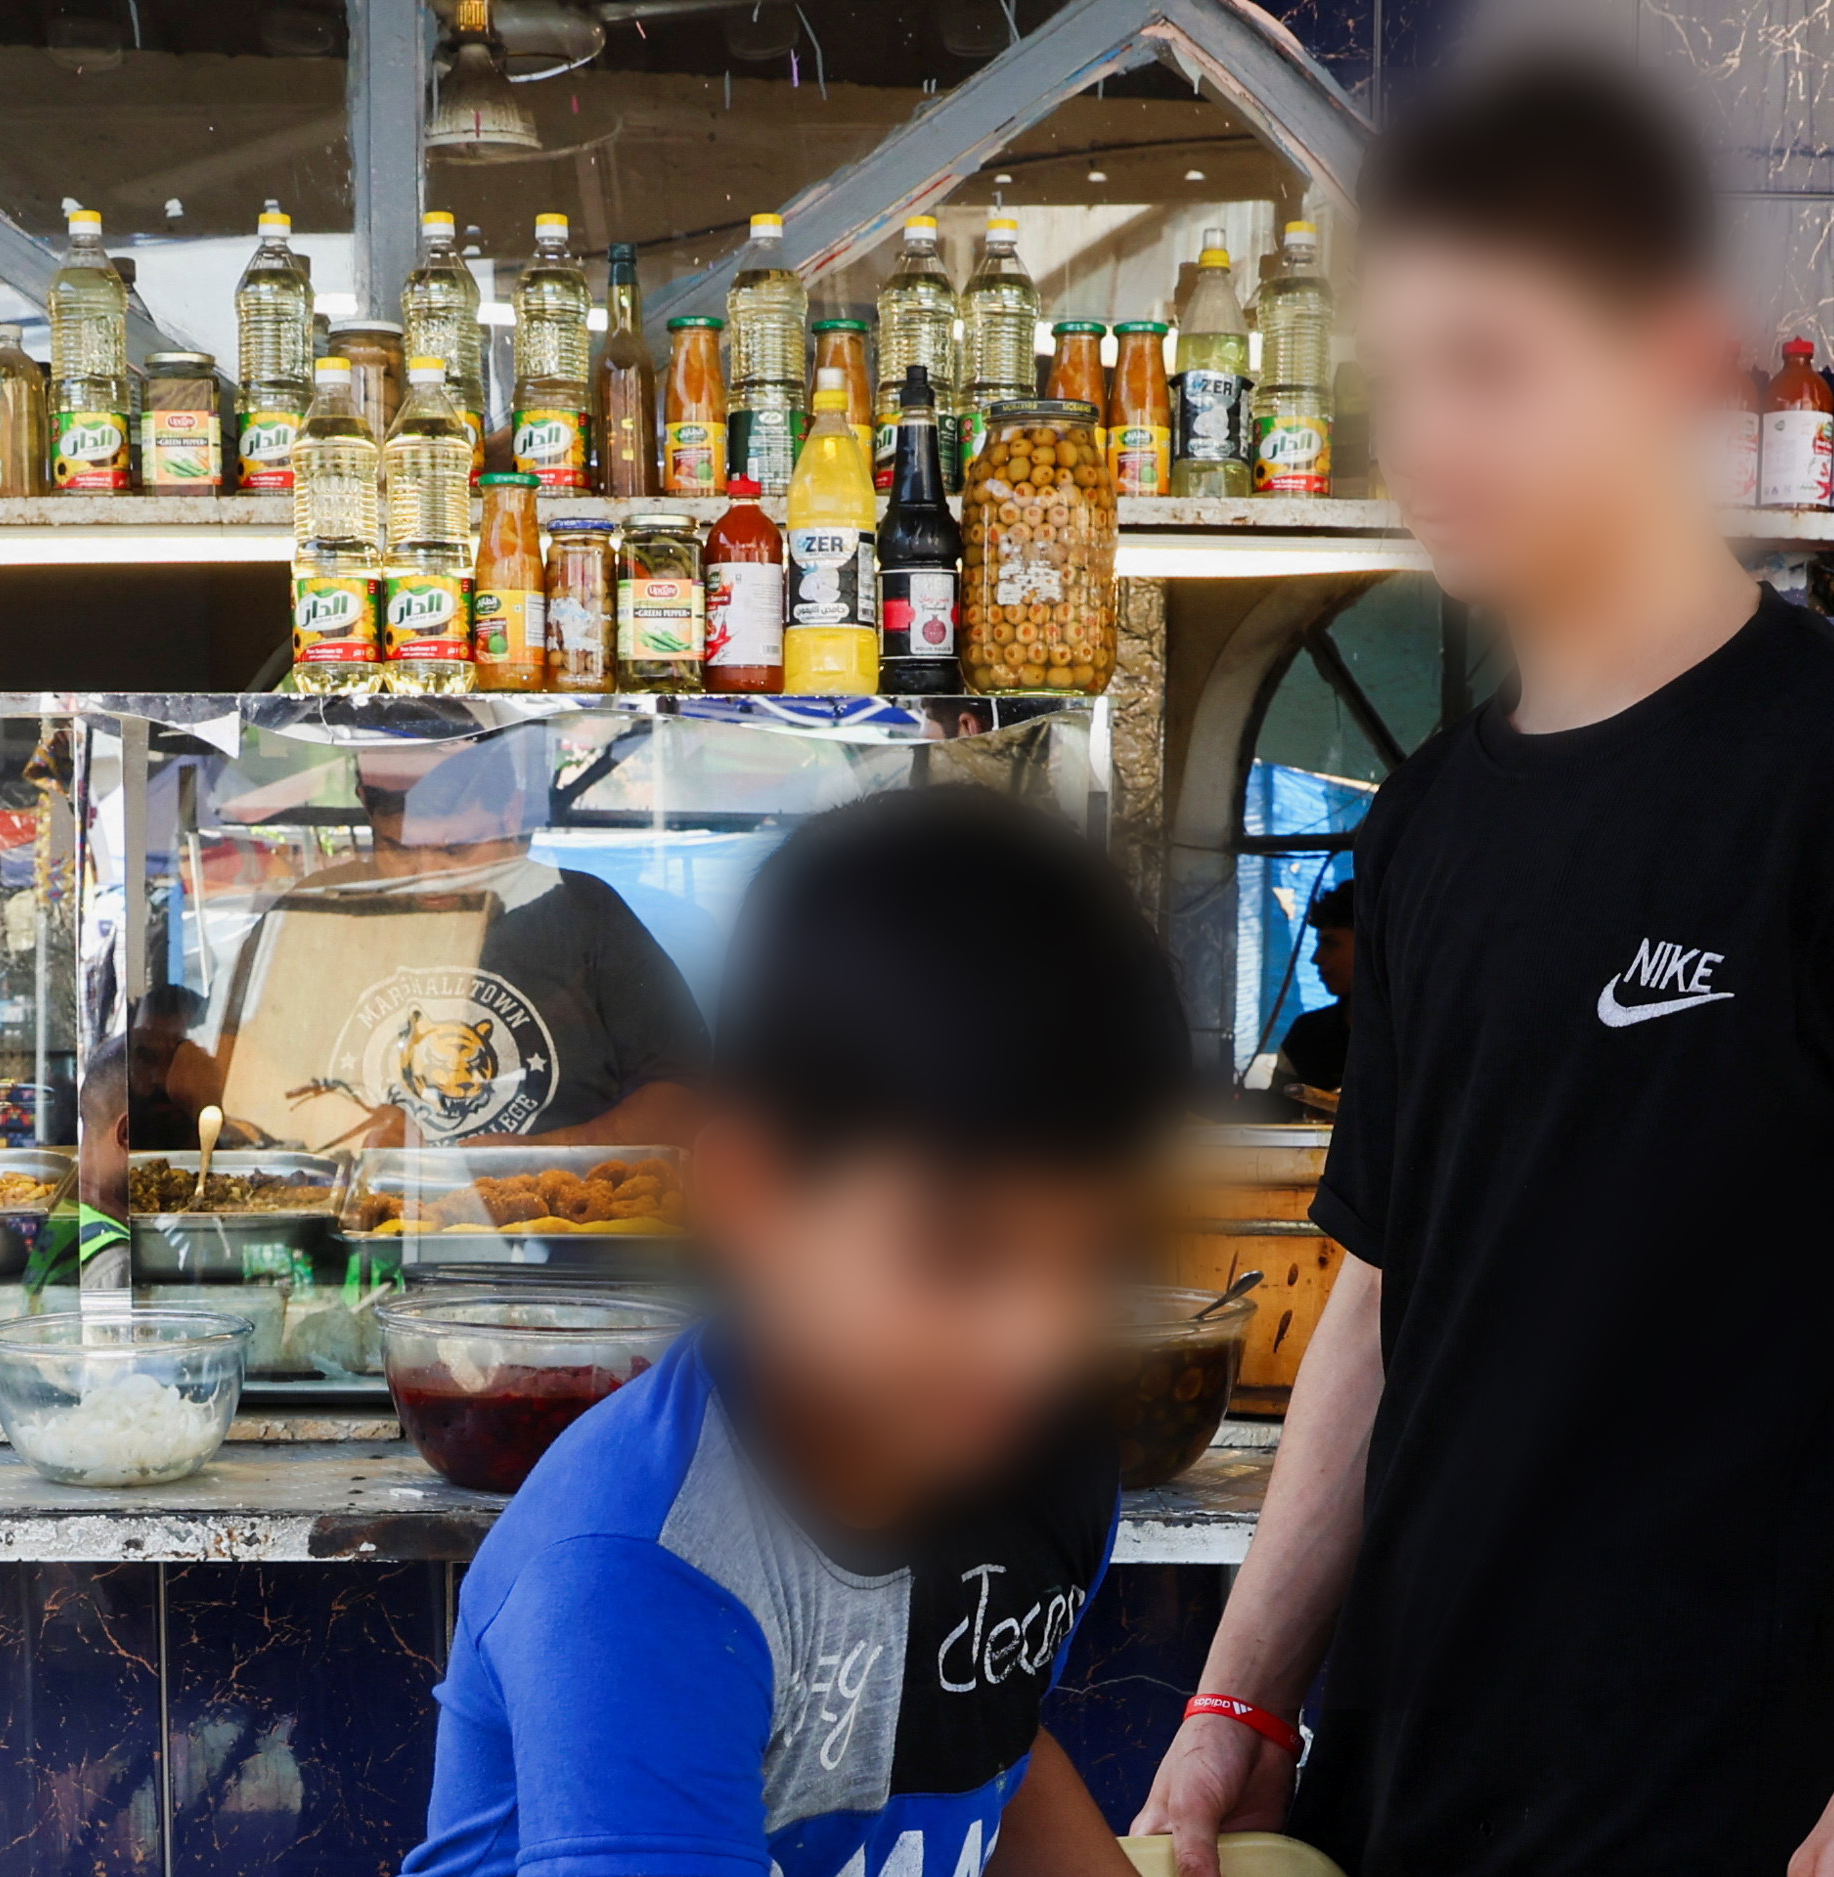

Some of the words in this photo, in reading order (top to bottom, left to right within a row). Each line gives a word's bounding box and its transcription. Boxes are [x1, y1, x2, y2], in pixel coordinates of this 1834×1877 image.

[638, 609, 663, 617] GREEN
[663, 609, 688, 617] PEPPER
[1623, 937, 1726, 994] NIKE
[357, 976, 531, 1030] MARSHALLTOWN
